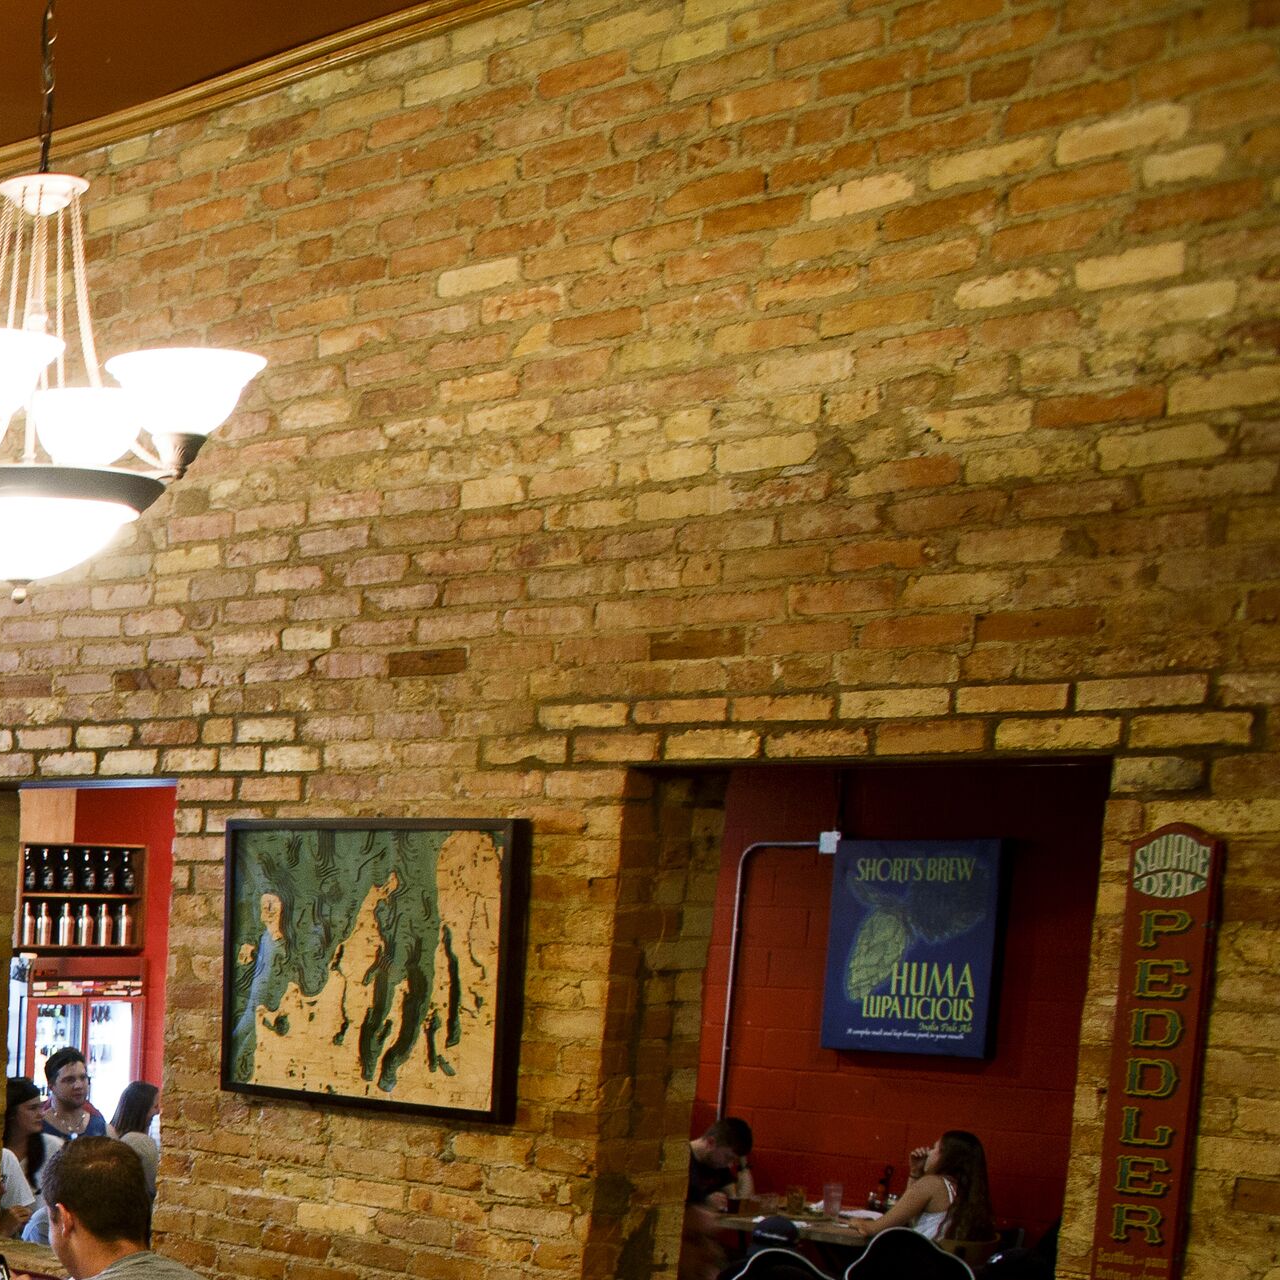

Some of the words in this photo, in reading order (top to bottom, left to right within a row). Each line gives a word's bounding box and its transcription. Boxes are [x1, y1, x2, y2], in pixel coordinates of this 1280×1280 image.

[856, 857, 923, 883] SHORT'S
[926, 856, 976, 883] BREW
[1135, 834, 1211, 878] SQUARE
[1141, 872, 1201, 897] DEAL
[890, 962, 975, 997] HUMA
[1111, 909, 1192, 1244] PEDDLER
